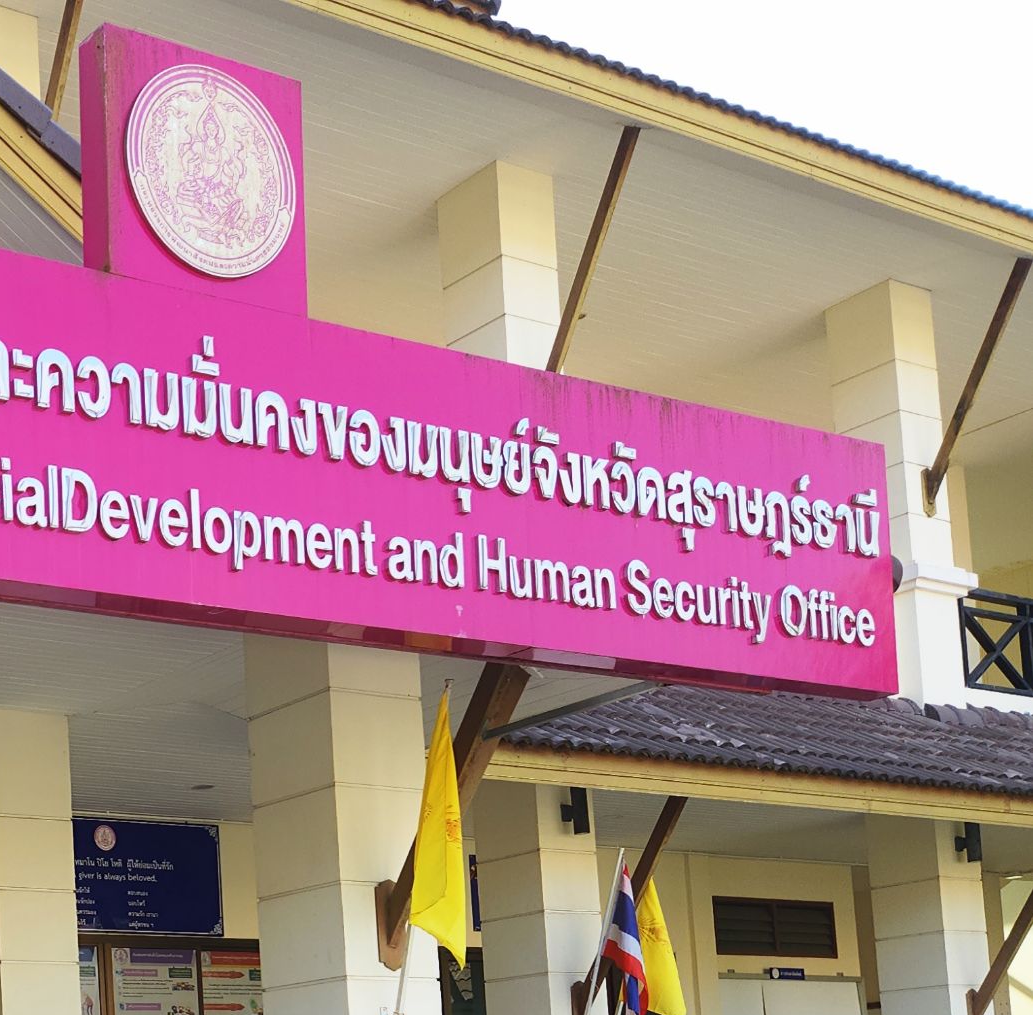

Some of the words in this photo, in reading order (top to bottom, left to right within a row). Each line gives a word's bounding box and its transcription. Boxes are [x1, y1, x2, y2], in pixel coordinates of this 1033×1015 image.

[388, 532, 465, 588] and
[478, 534, 617, 611] Human
[627, 559, 771, 645] Security
[780, 584, 876, 648] Office
[78, 871, 95, 881] giver
[96, 872, 102, 880] is
[103, 872, 127, 882] always
